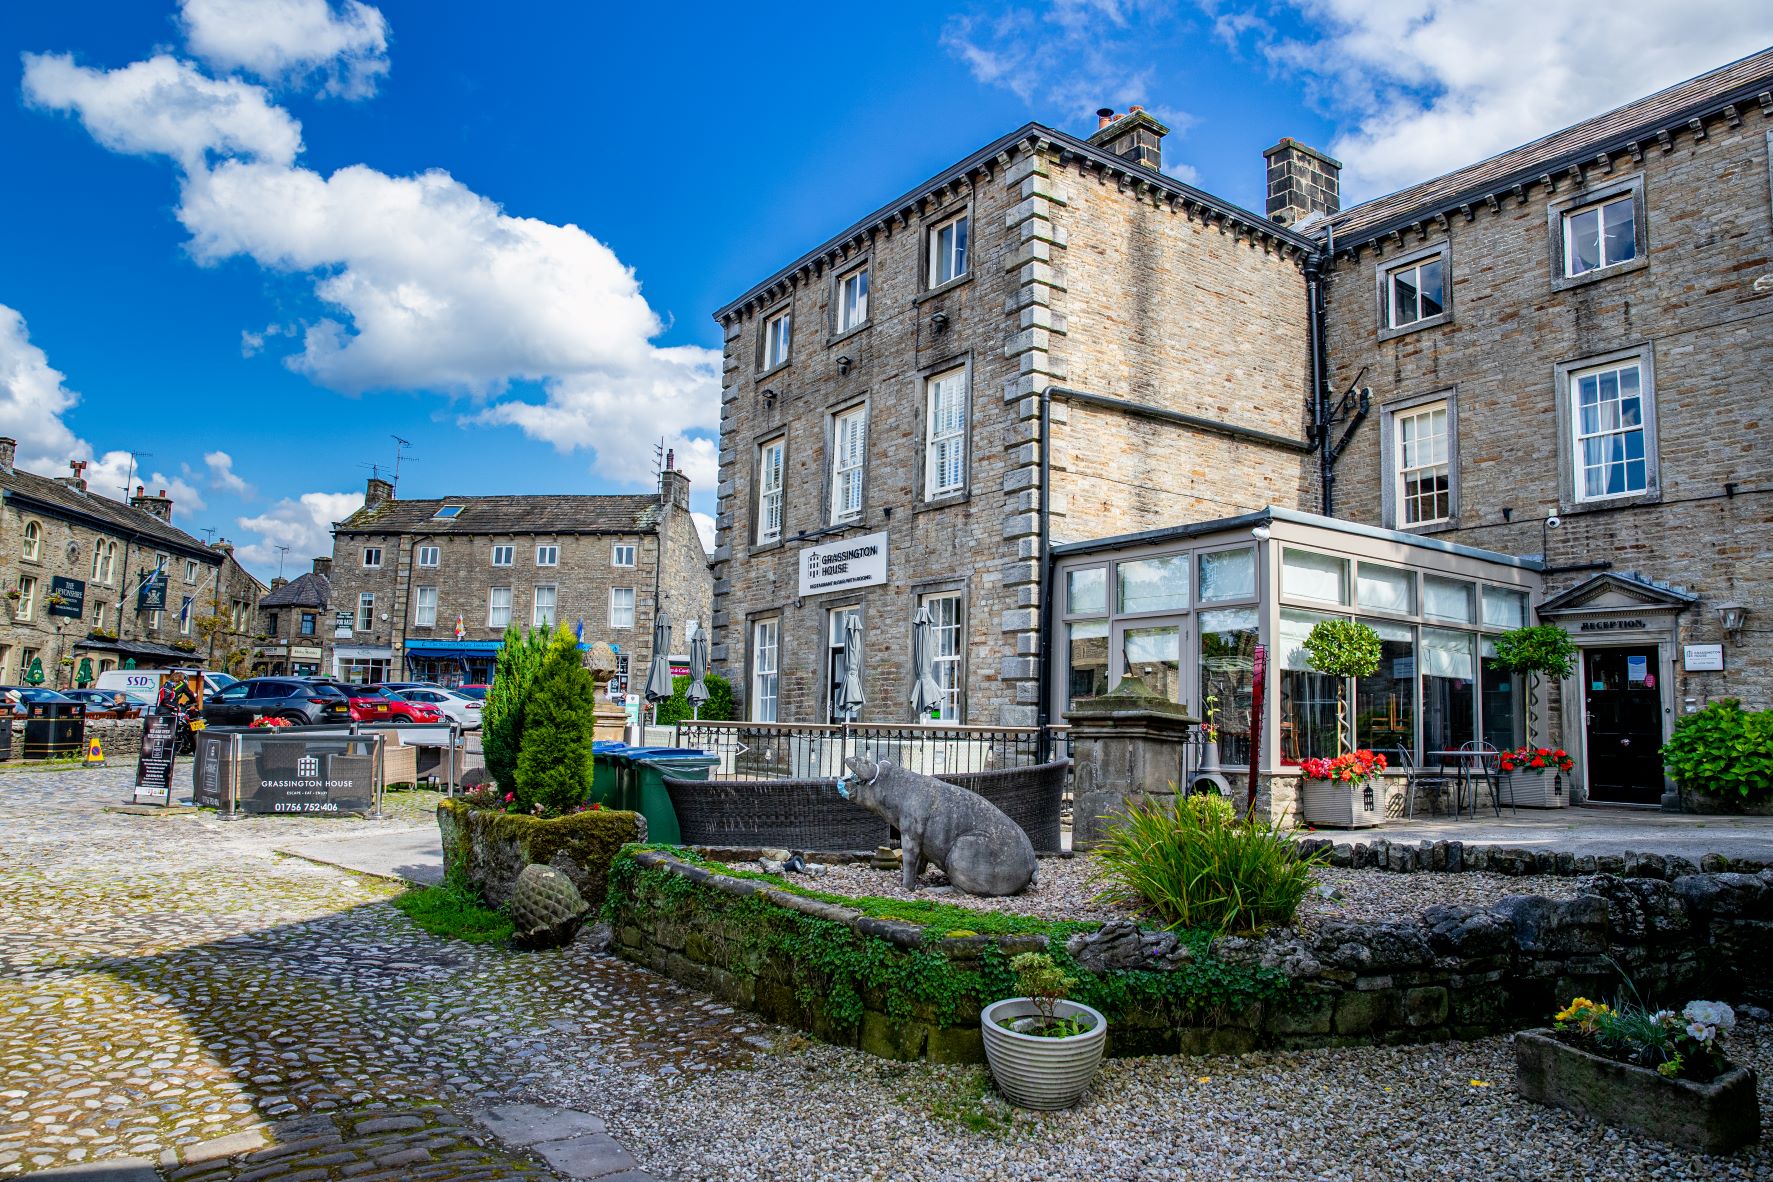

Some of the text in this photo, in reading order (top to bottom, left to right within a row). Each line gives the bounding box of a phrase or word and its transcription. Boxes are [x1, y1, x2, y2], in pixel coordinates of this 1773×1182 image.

[821, 545, 878, 565] GRASSINGTON
[821, 563, 848, 576] HOUSE
[809, 580, 834, 590] RESTAURANT
[55, 587, 83, 599] DEVONSHIRE
[1581, 619, 1645, 631] RECEPTION
[126, 676, 148, 686] SSD
[261, 780, 353, 788] GRASSINGTON HOUSE
[274, 803, 338, 812] 01756 752 406
